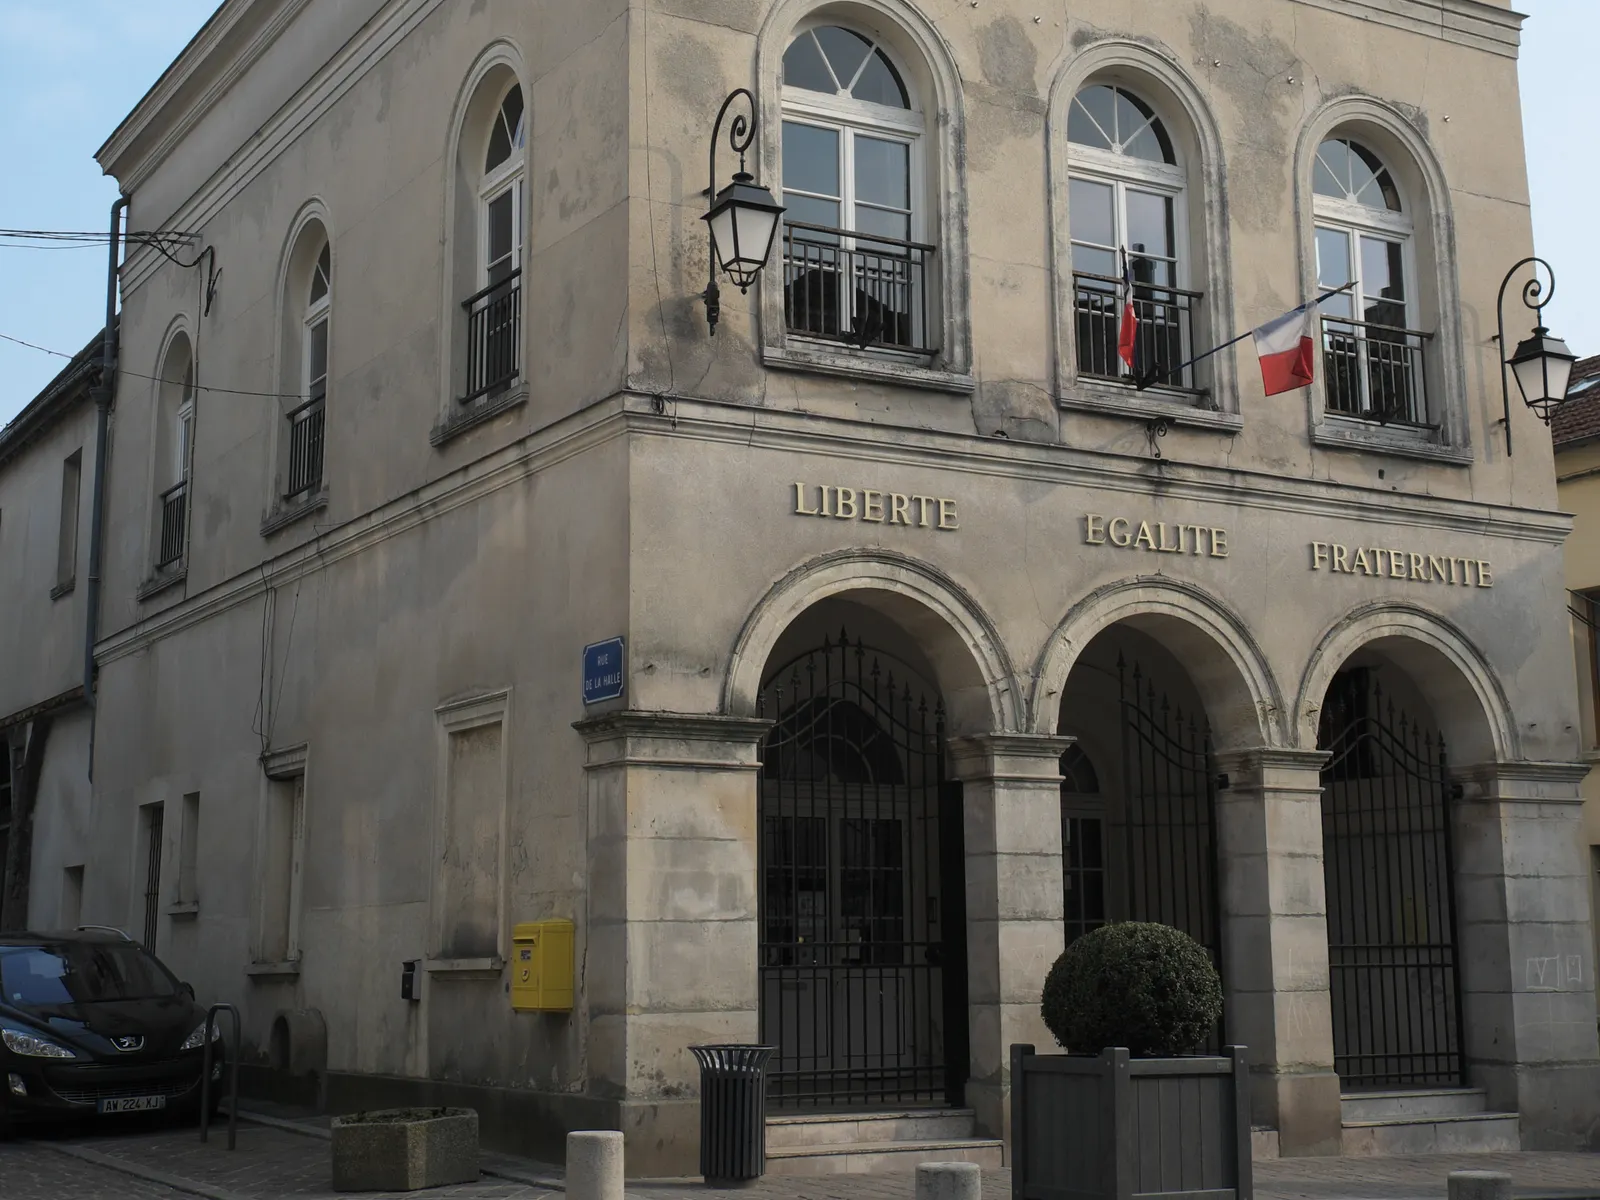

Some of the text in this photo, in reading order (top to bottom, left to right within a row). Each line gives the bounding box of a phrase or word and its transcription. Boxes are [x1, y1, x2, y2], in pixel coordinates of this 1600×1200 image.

[794, 482, 958, 530] LIBERTE
[1084, 513, 1229, 558] EGALITE
[1311, 541, 1492, 588] FRATERNITE
[585, 672, 621, 691] DE LA HALLE
[597, 653, 609, 667] RUE
